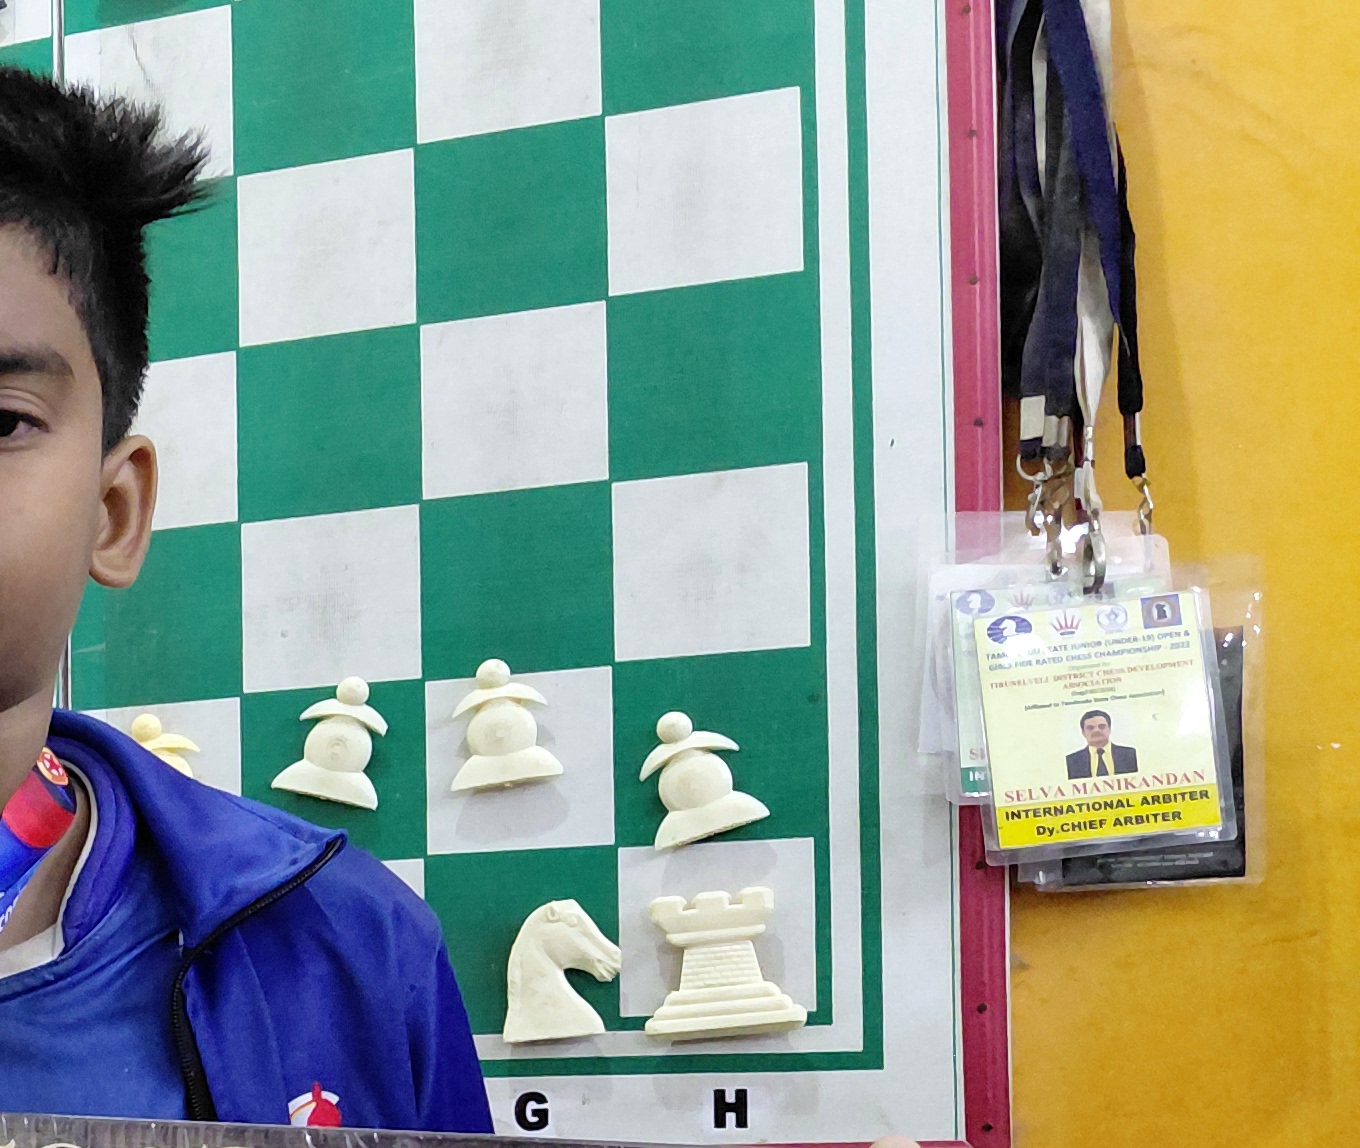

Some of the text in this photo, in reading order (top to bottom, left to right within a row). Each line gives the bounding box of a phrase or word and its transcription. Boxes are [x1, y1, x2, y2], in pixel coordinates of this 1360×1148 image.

[1035, 656, 1063, 666] RATED
[1004, 769, 1206, 804] SELVA MANIKANDAN
[1005, 789, 1211, 822] INTERNATIONAL ARBITER
[1113, 810, 1182, 828] ARBITER
[514, 1089, 748, 1131] G H
